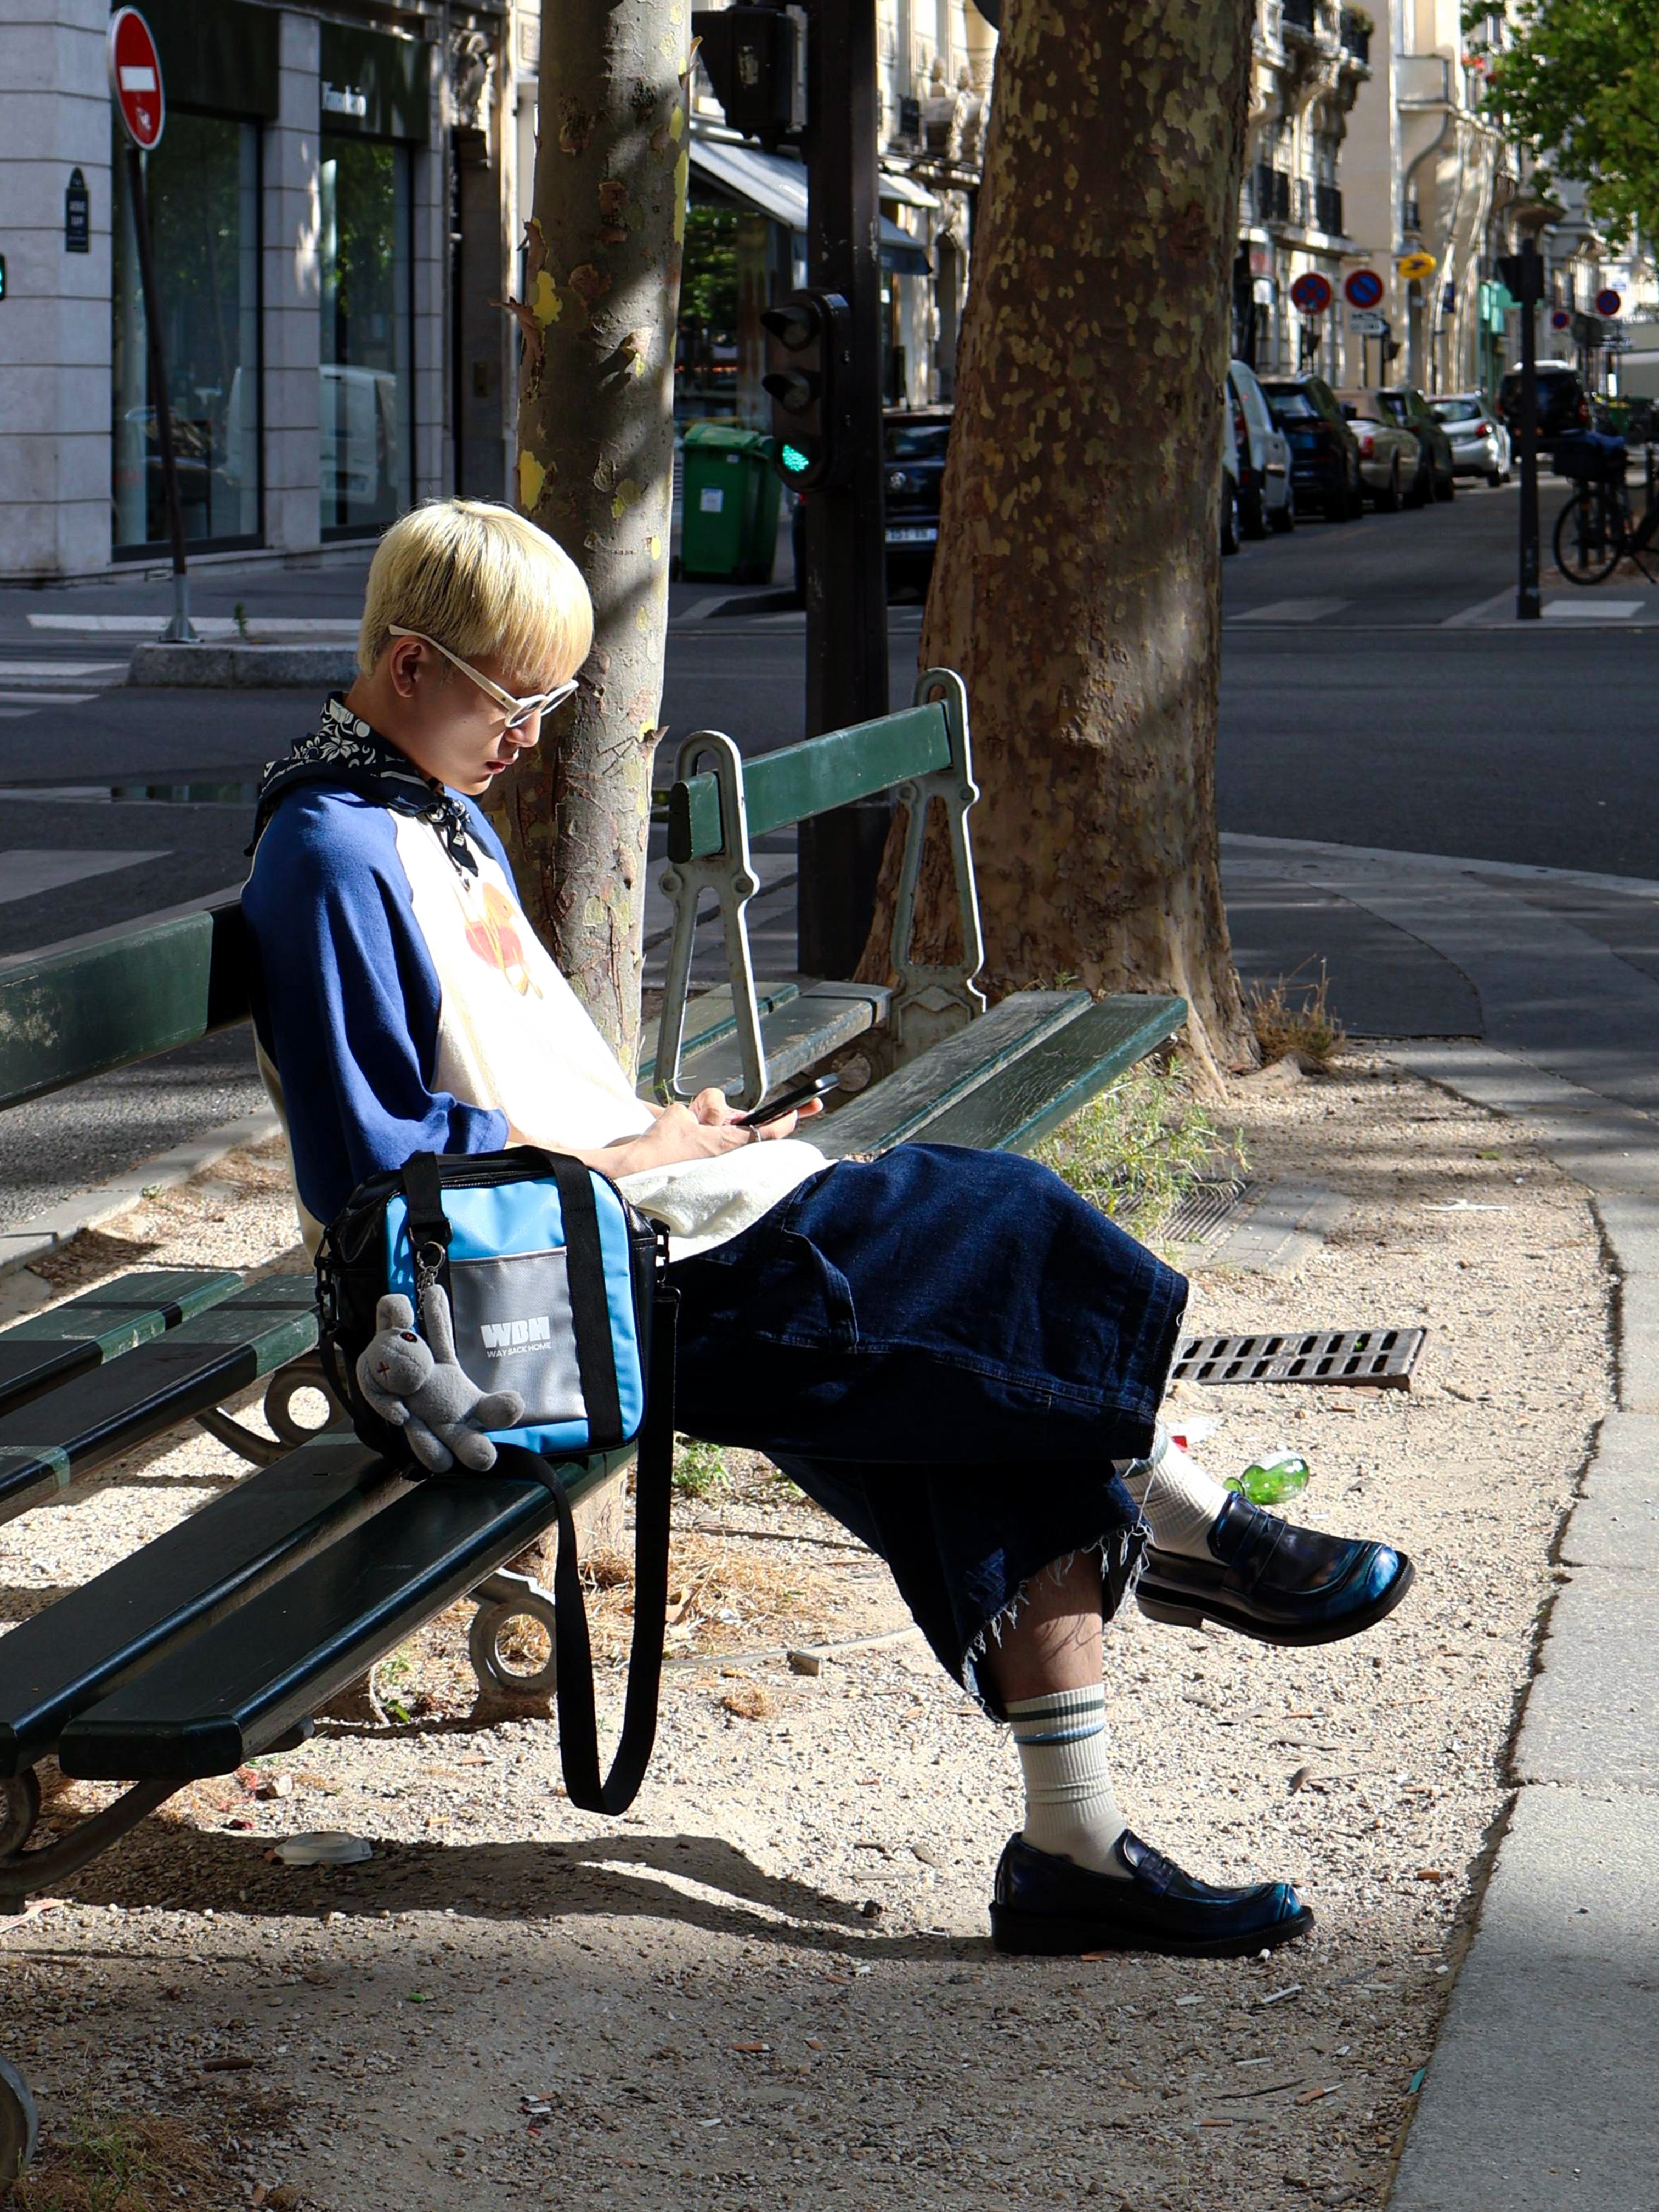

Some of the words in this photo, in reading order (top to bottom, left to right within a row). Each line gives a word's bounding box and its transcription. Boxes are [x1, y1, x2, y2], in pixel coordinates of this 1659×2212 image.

[480, 1316, 551, 1348] WBH
[487, 1349, 506, 1358] WAY
[508, 1345, 527, 1355] BACK
[528, 1342, 551, 1351] HOME
